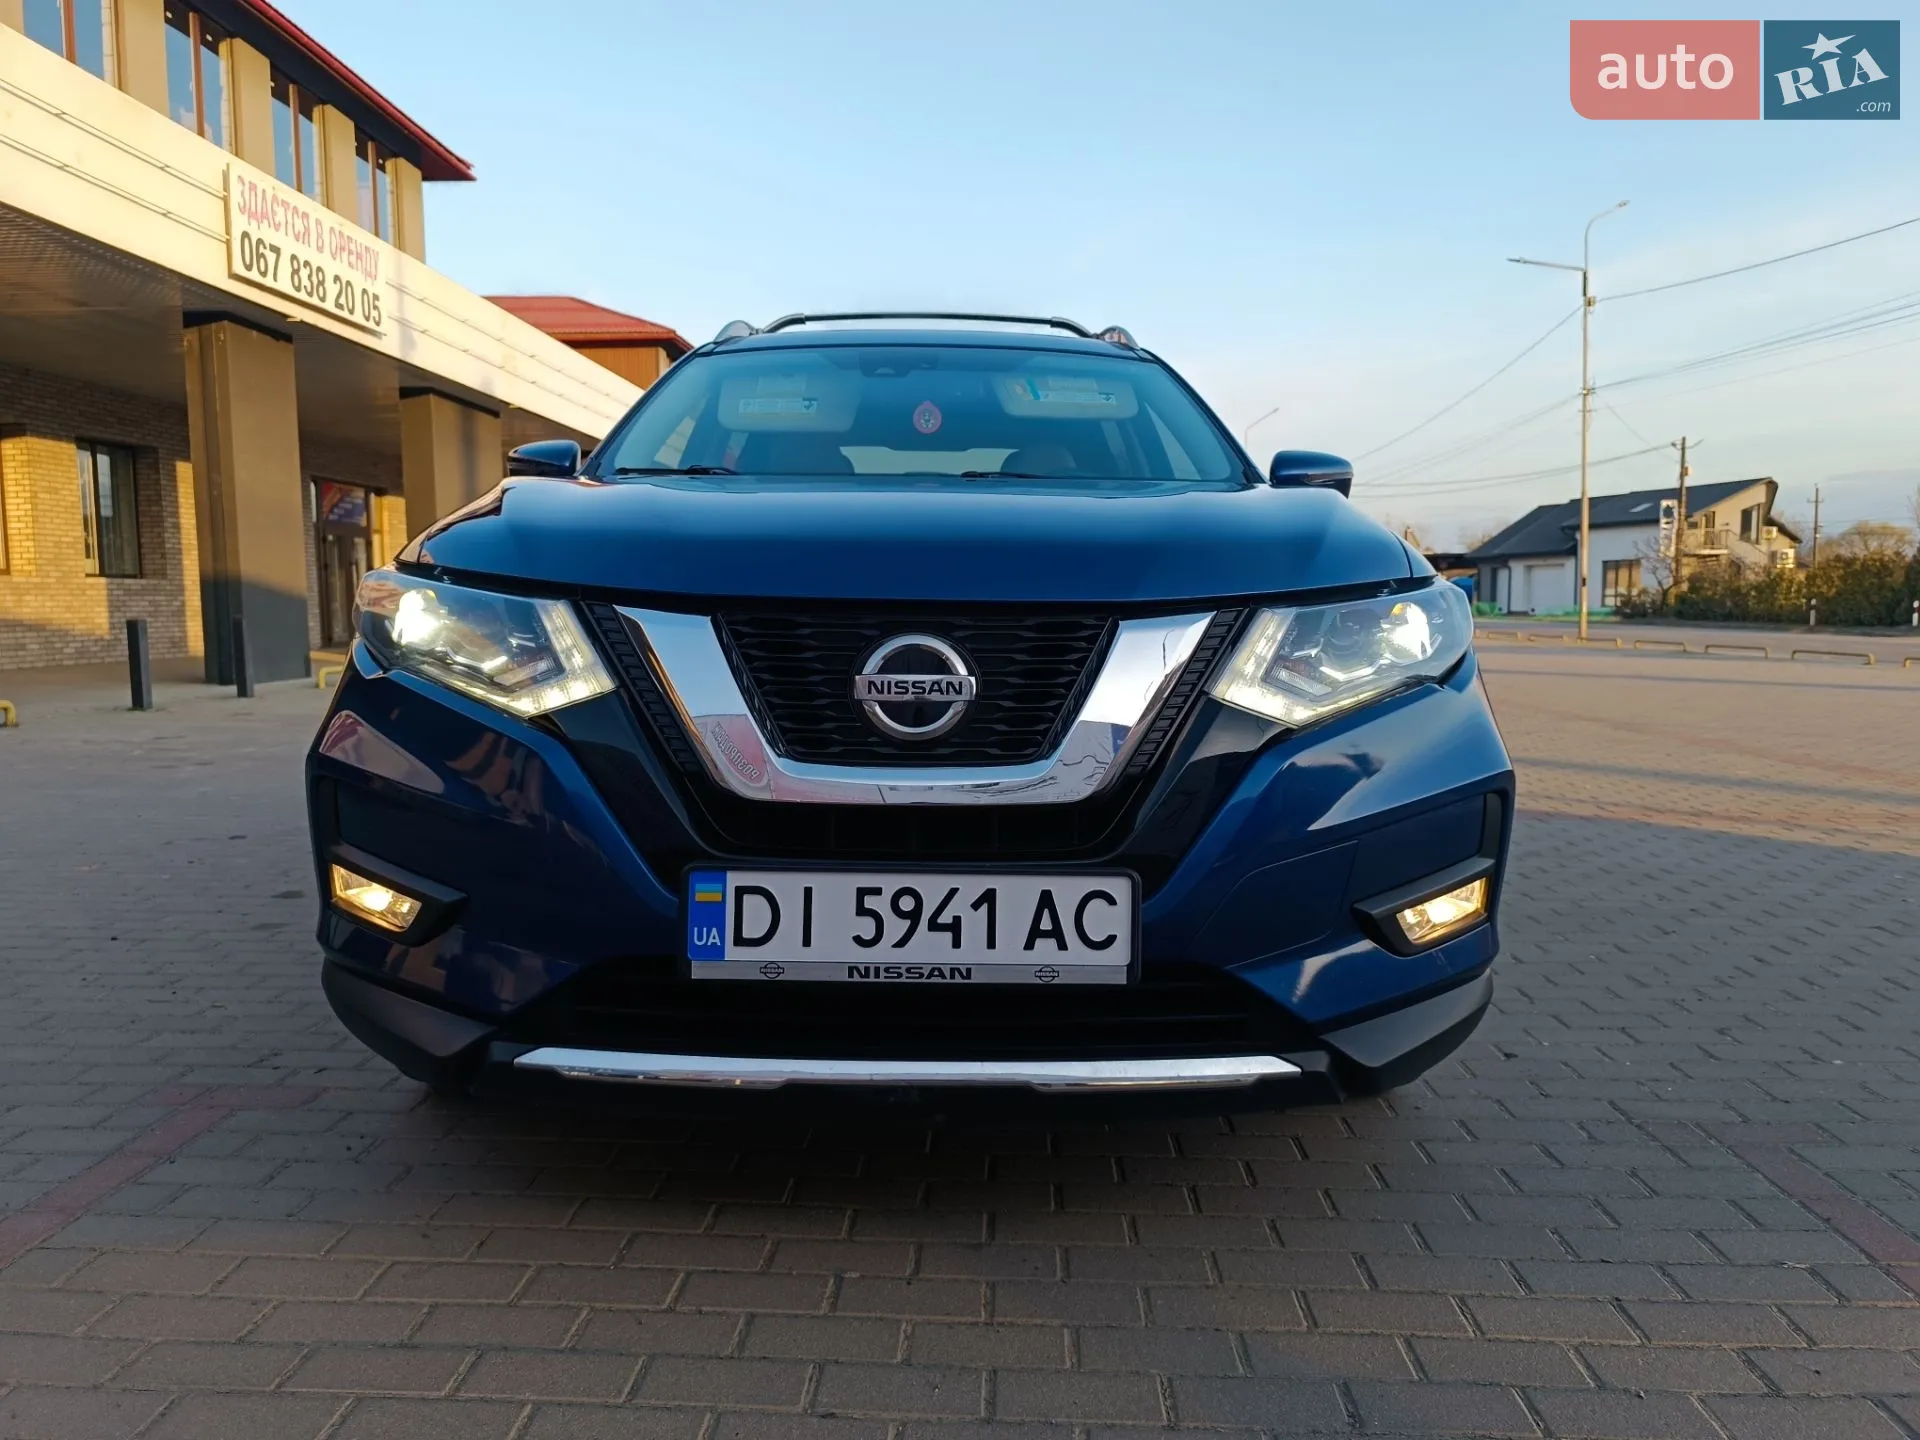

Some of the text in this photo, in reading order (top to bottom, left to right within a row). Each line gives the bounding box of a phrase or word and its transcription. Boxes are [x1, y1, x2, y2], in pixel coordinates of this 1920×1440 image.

[237, 175, 380, 285] ЗДАЄТСЯ В ОРЕНДУ
[240, 230, 382, 327] 067 838 20 05
[867, 679, 964, 696] NISSAN
[693, 927, 721, 946] UA
[733, 885, 1118, 952] DI 5941 AC
[847, 965, 972, 981] NISSAN
